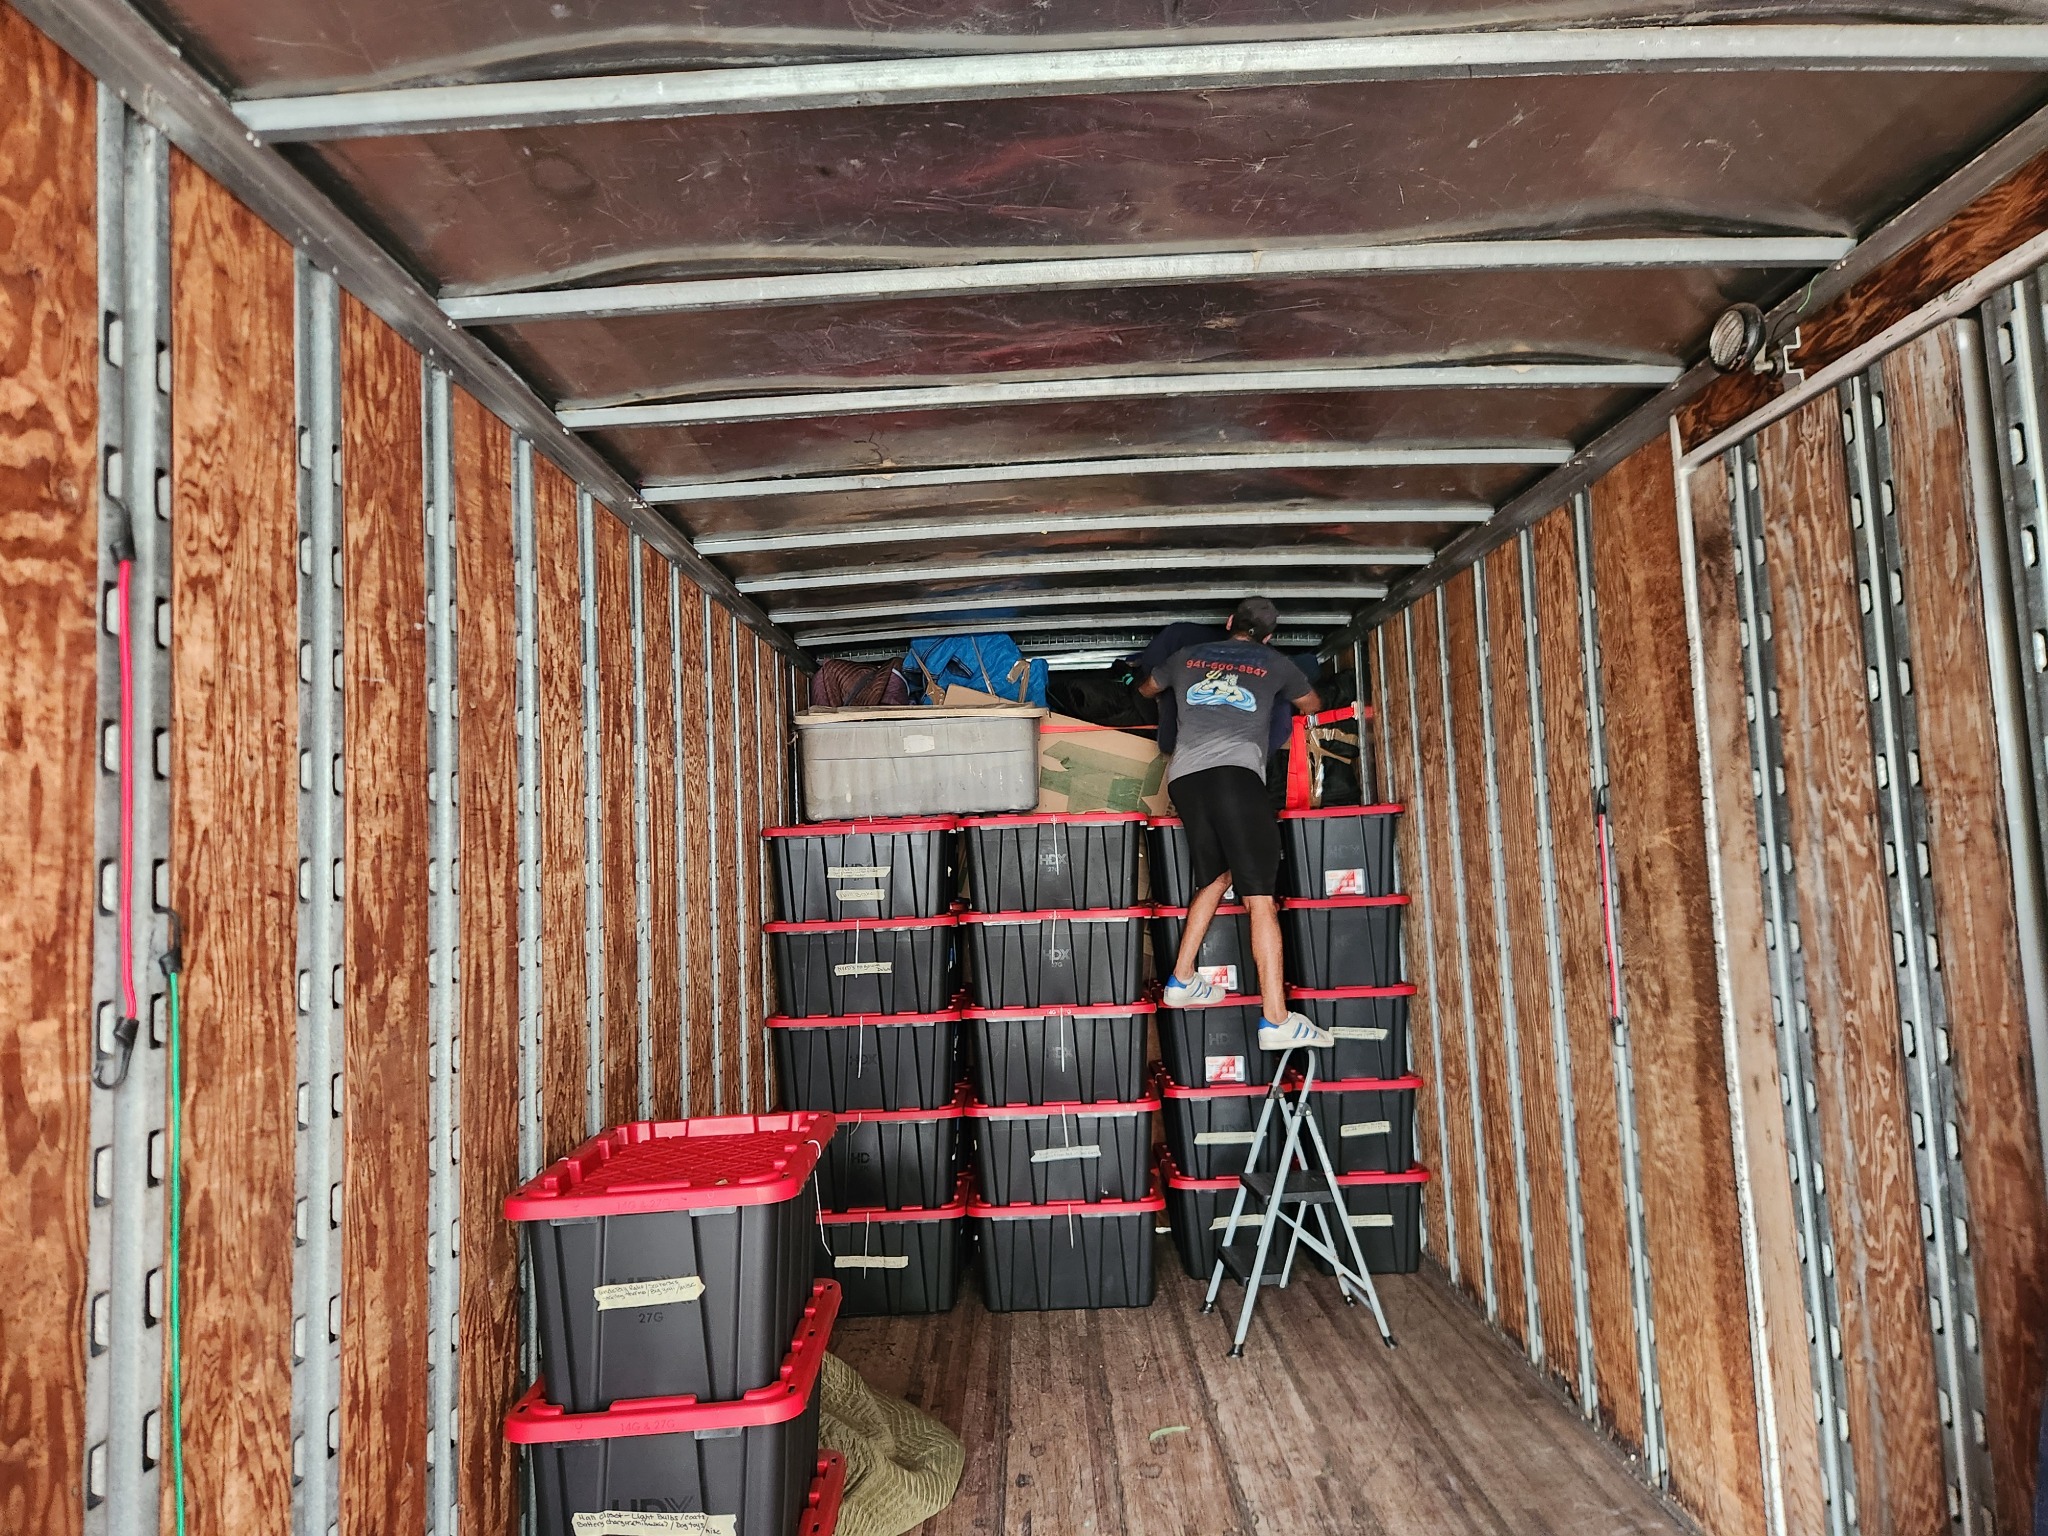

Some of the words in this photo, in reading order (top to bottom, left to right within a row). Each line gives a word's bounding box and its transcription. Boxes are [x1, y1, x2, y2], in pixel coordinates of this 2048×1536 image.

[638, 1311, 665, 1324] 27G
[620, 1422, 641, 1433] 14G
[654, 1418, 675, 1430] 27G
[631, 1513, 654, 1522] Light
[656, 1513, 679, 1521] Bulbs
